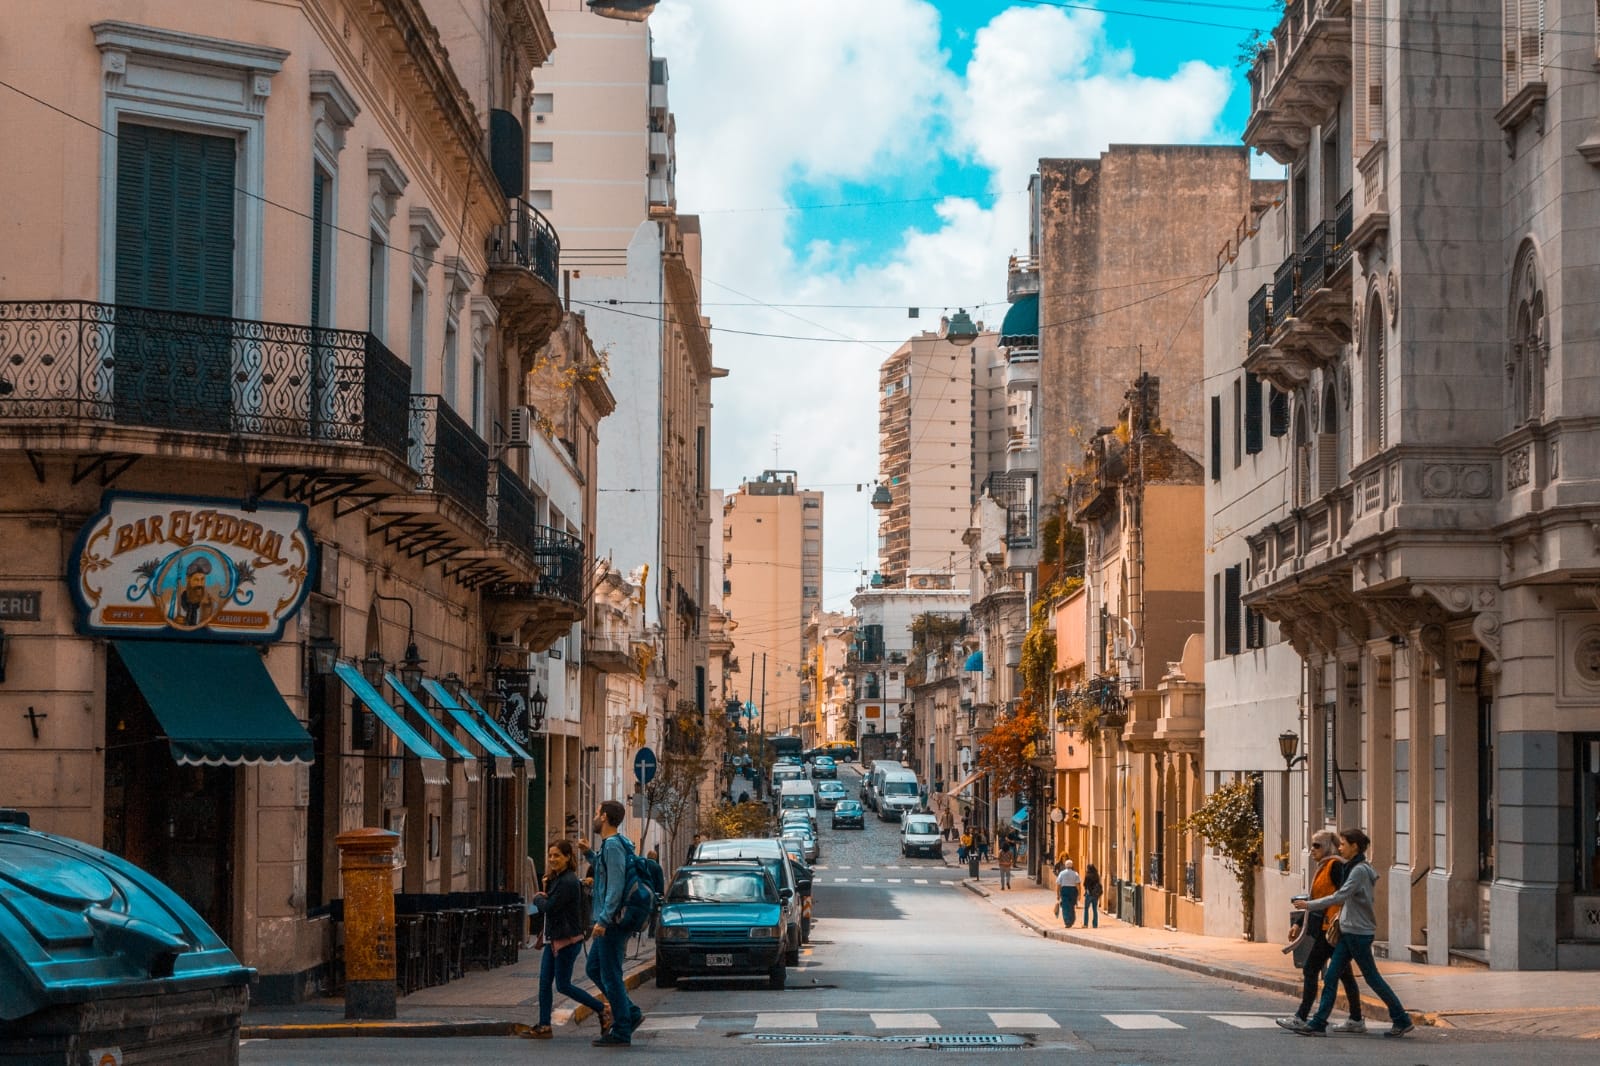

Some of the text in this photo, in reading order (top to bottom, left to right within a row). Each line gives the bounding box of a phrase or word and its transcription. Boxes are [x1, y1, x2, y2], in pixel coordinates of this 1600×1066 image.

[112, 509, 289, 569] BAR EL FEDERAL
[0, 594, 33, 614] ERÚ
